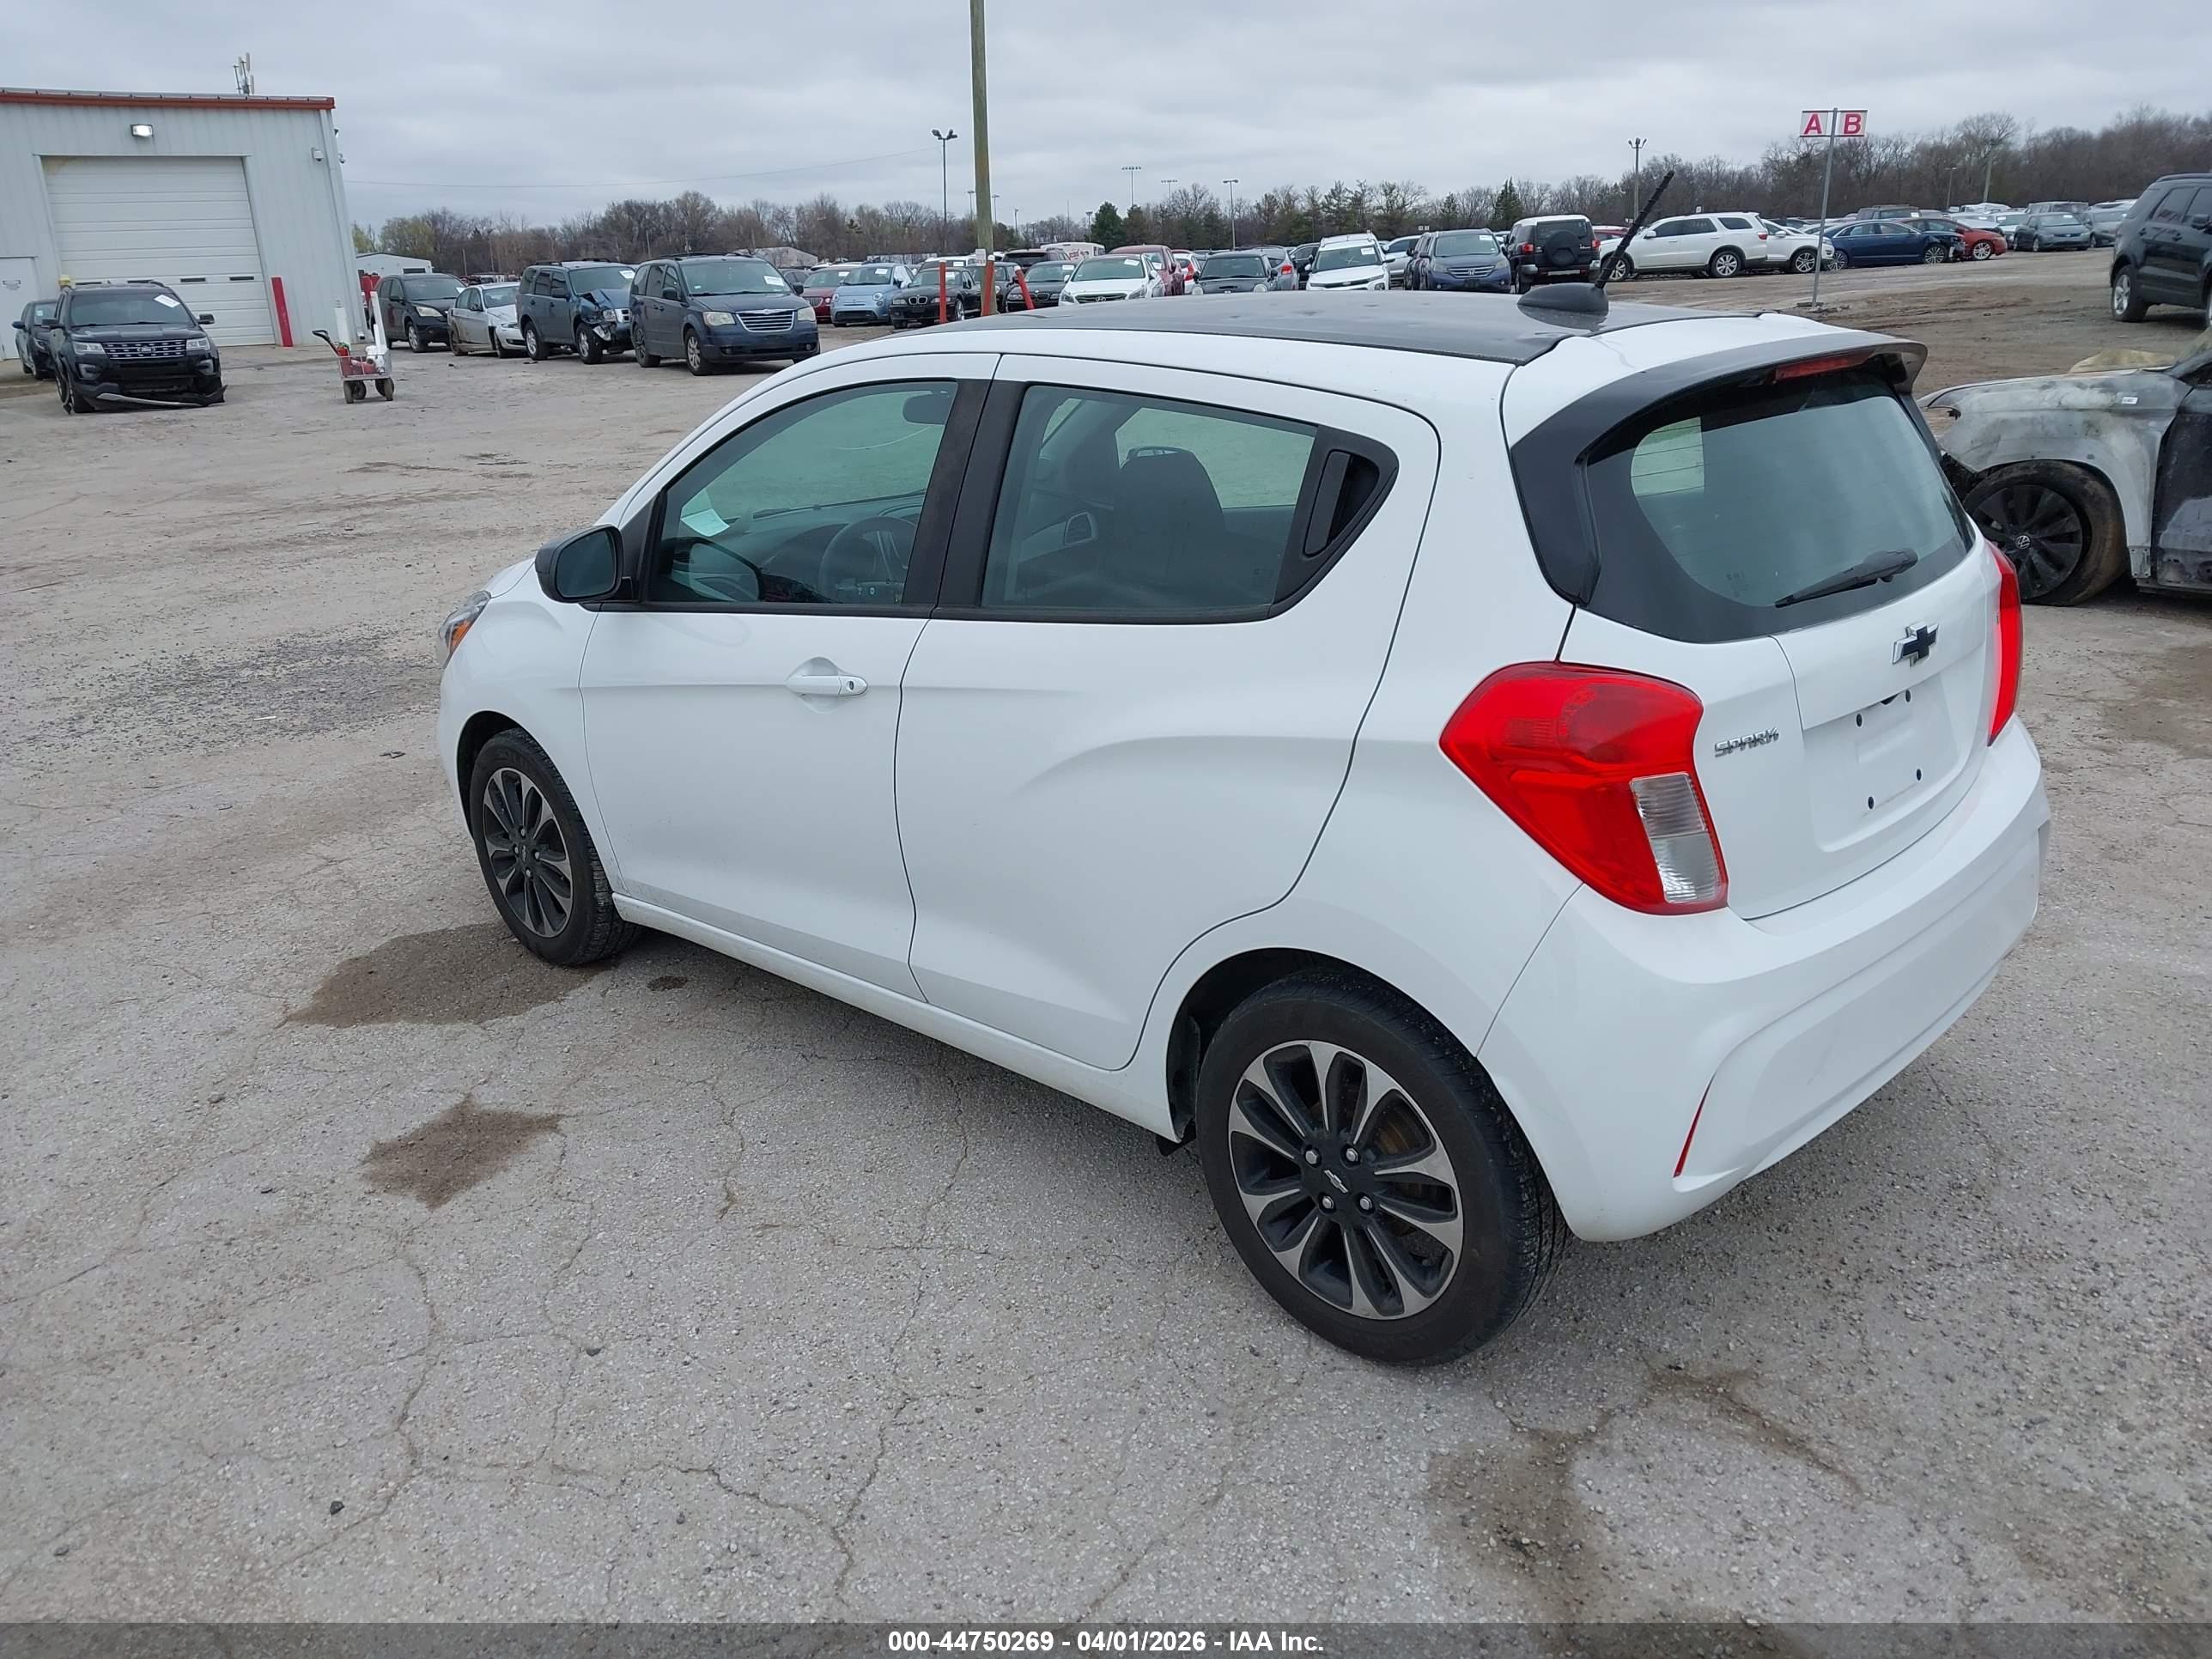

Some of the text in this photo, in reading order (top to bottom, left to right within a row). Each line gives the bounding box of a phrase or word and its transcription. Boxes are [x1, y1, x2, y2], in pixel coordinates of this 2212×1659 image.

[1804, 113, 1822, 134] A
[1844, 113, 1862, 134] B
[1715, 727, 1779, 757] SPARK
